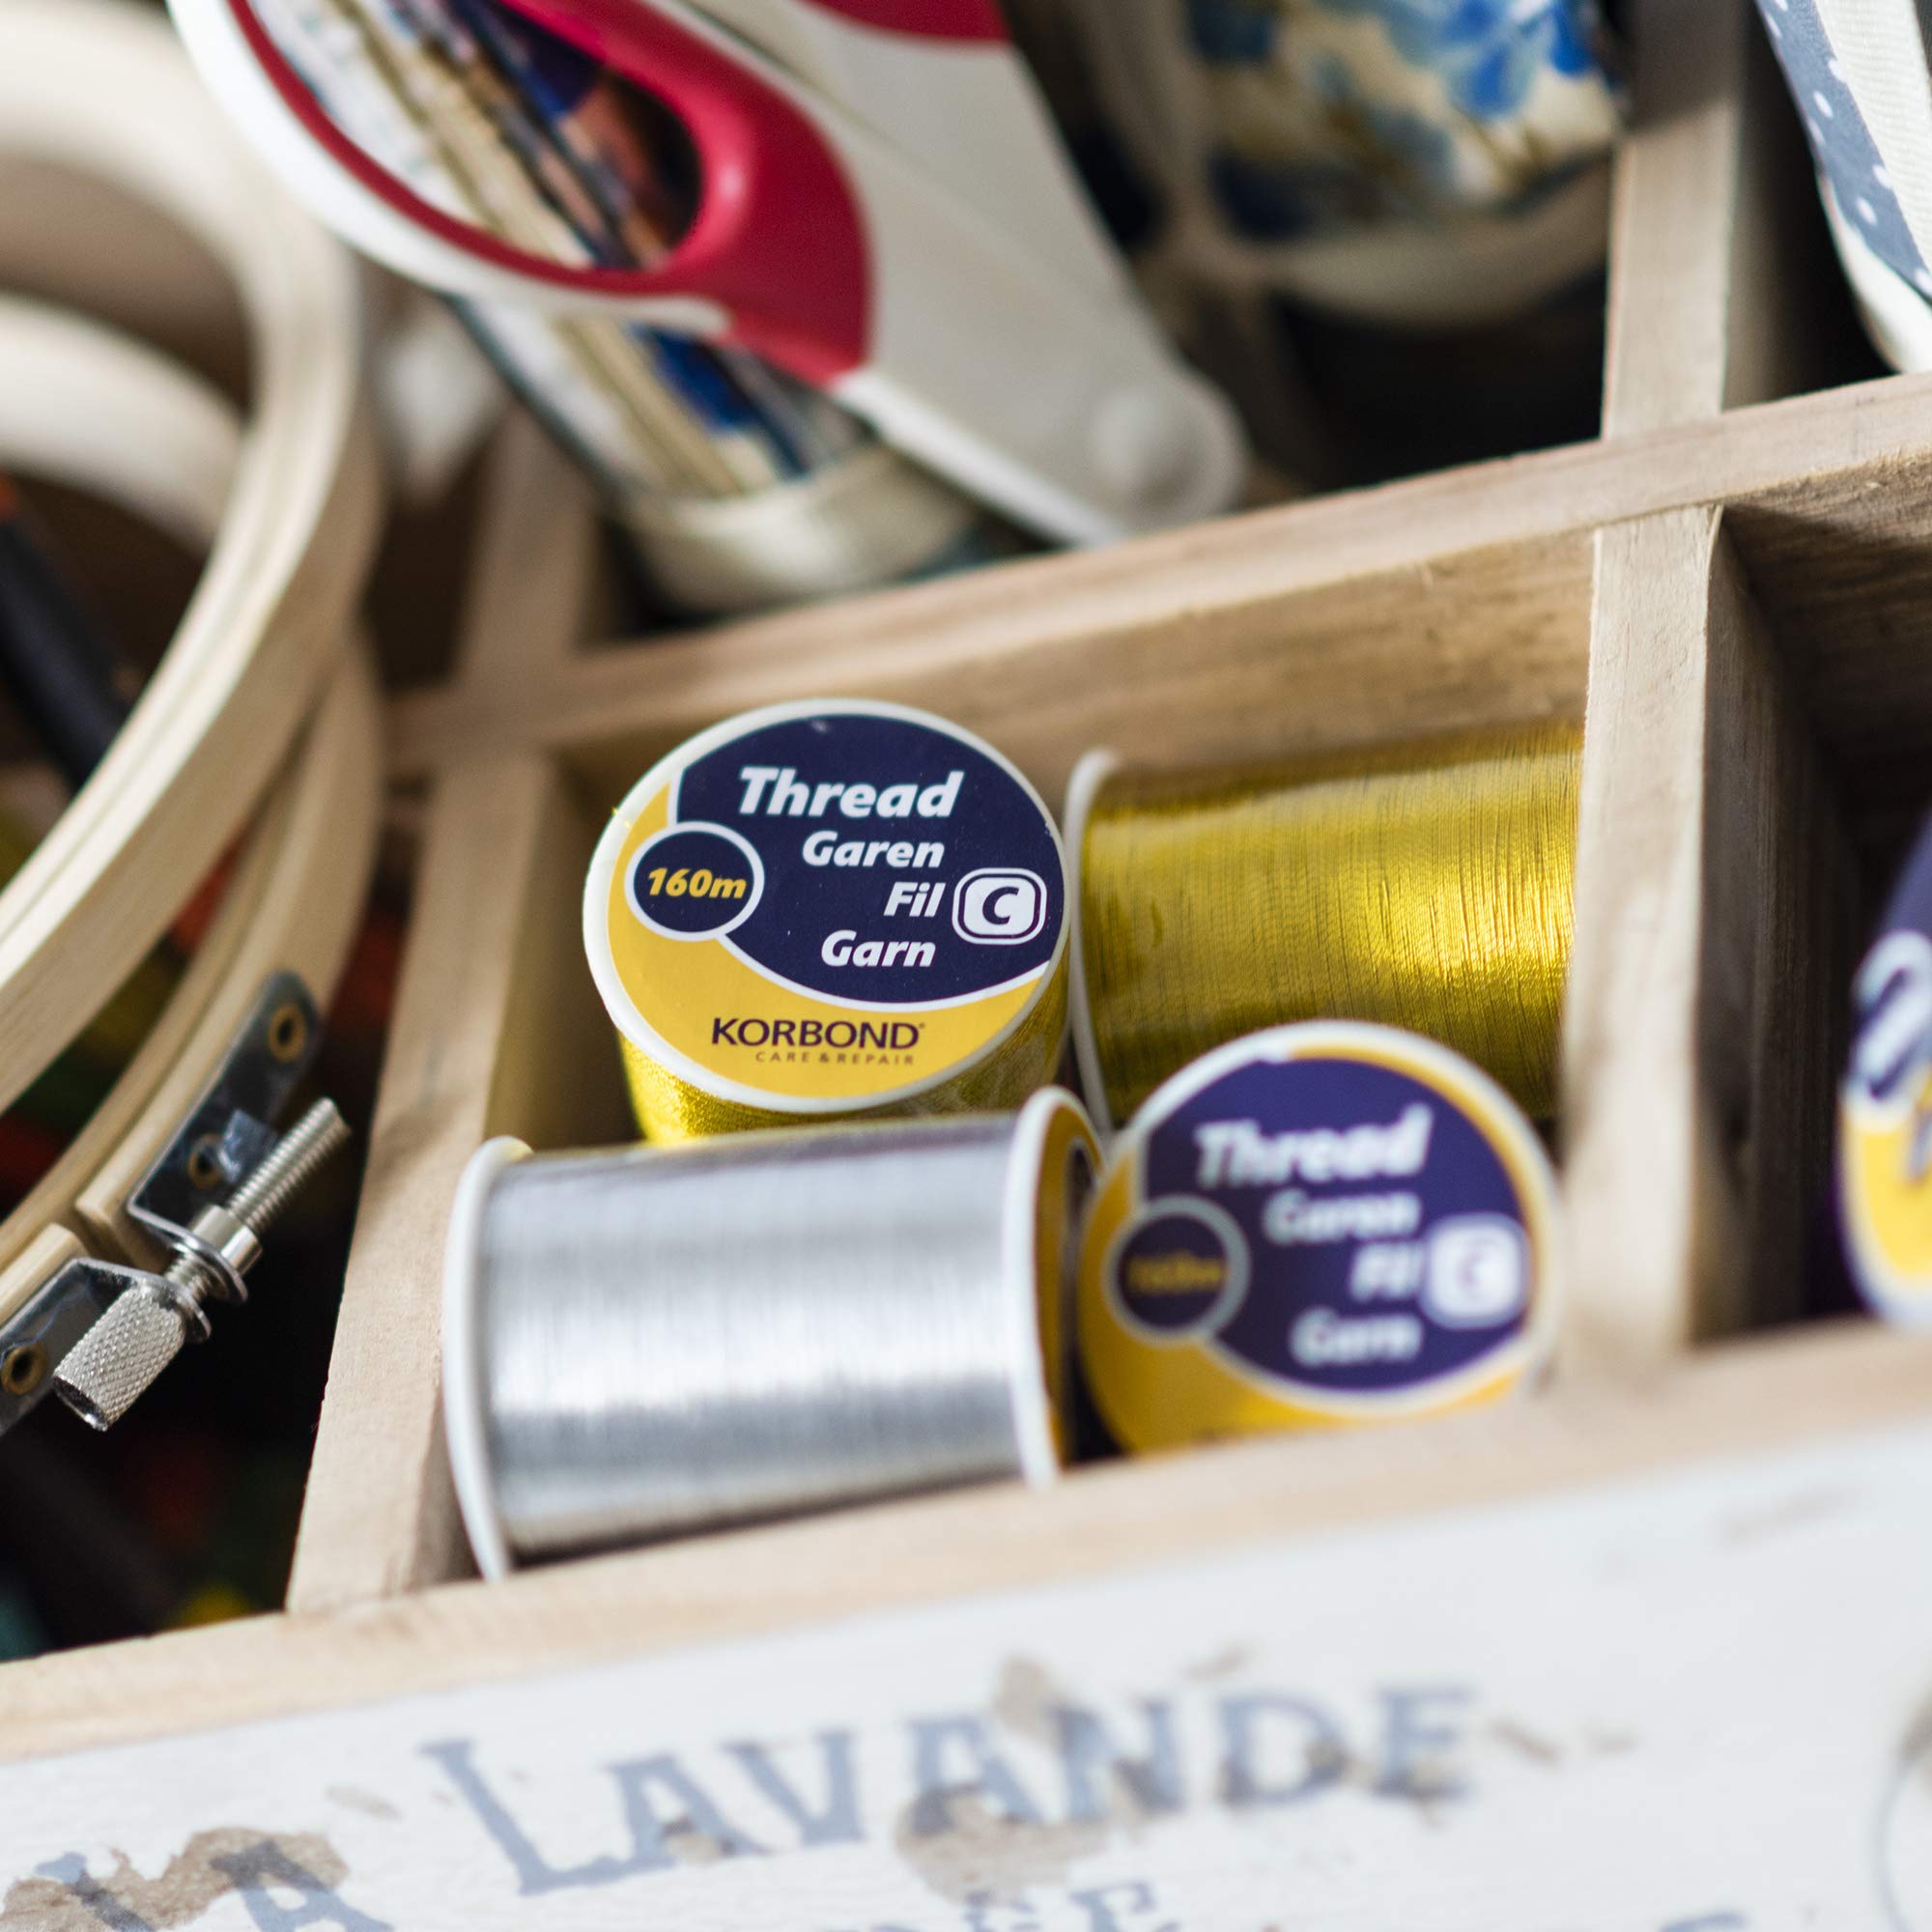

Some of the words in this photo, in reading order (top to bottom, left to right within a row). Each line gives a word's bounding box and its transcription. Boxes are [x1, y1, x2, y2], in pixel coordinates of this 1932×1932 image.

[739, 766, 964, 818] Thread
[802, 830, 945, 867] Garen
[647, 867, 747, 898] 160m
[883, 881, 945, 918] Fil
[821, 929, 936, 967] Garn
[711, 1017, 921, 1049] KORBOND
[755, 1051, 810, 1064] CARE
[819, 1052, 830, 1064] &
[837, 1053, 914, 1065] REPAIR
[1194, 1102, 1434, 1189] Thread
[1264, 1189, 1422, 1245] Garen
[1290, 1308, 1423, 1366] Garn
[419, 1685, 1474, 1896] LAVANDE
